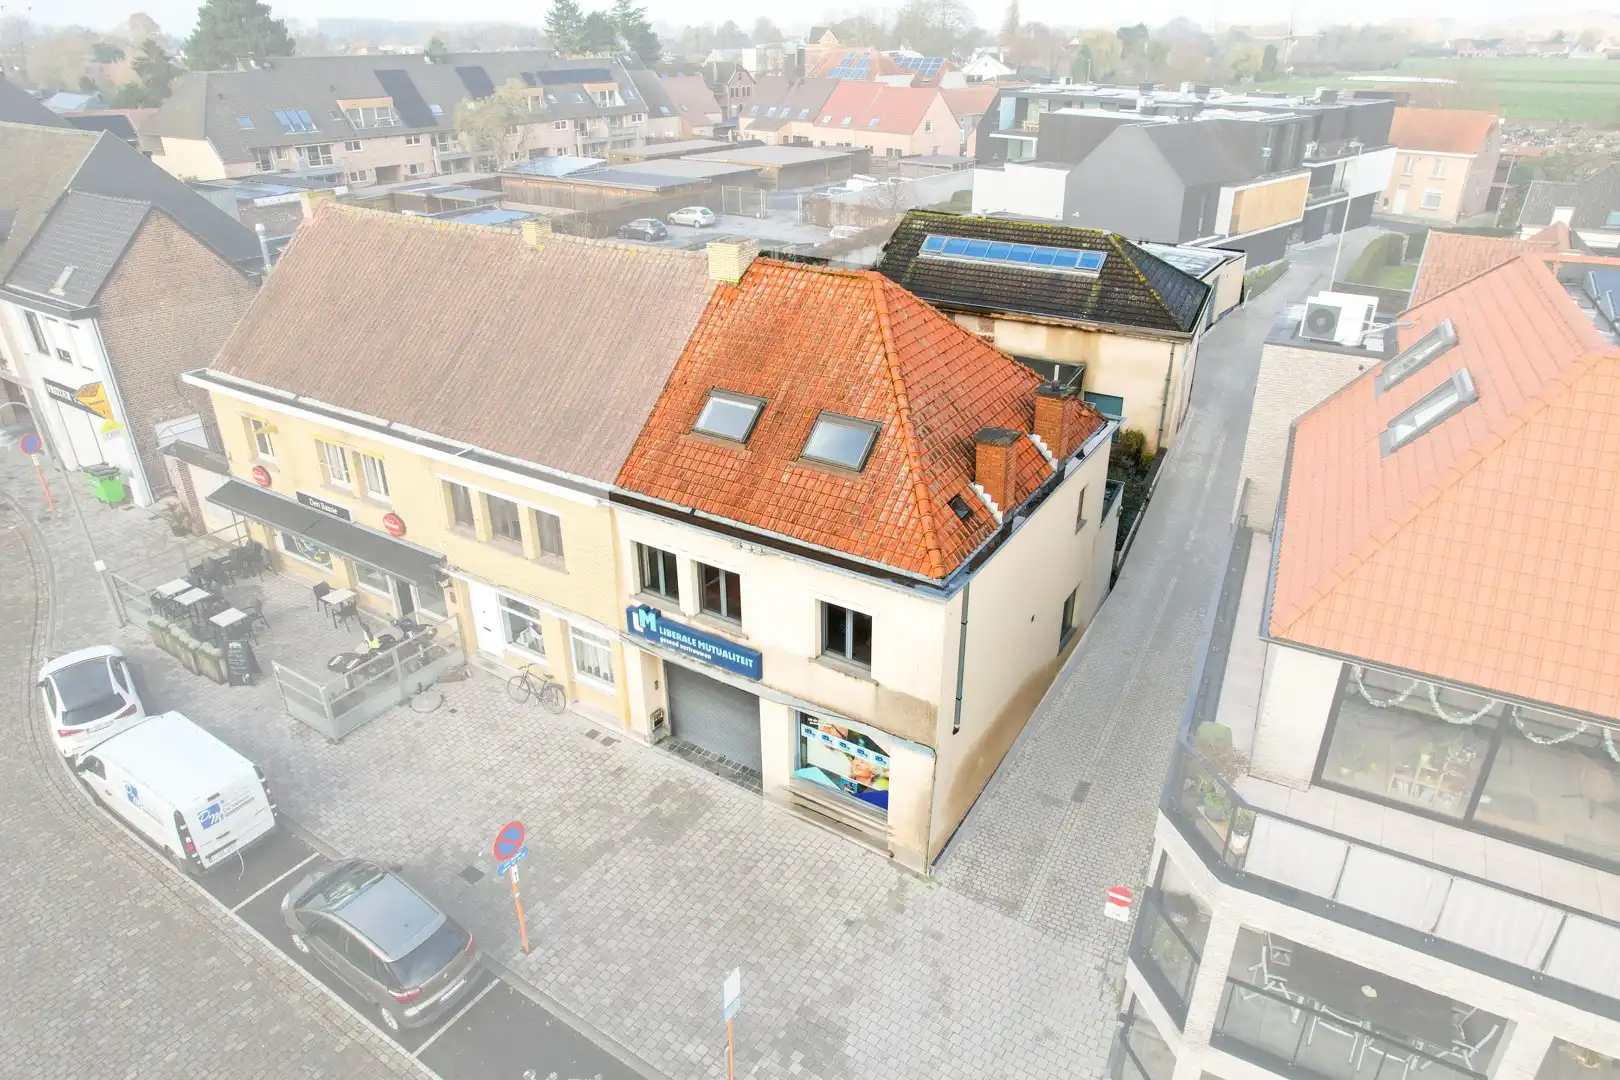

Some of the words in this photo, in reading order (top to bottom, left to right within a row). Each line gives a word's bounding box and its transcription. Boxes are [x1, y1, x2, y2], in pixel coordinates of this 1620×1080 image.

[309, 498, 321, 509] Den
[632, 608, 657, 633] LM
[659, 626, 697, 647] LIBERALE
[698, 640, 753, 669] MUTUALITEIT
